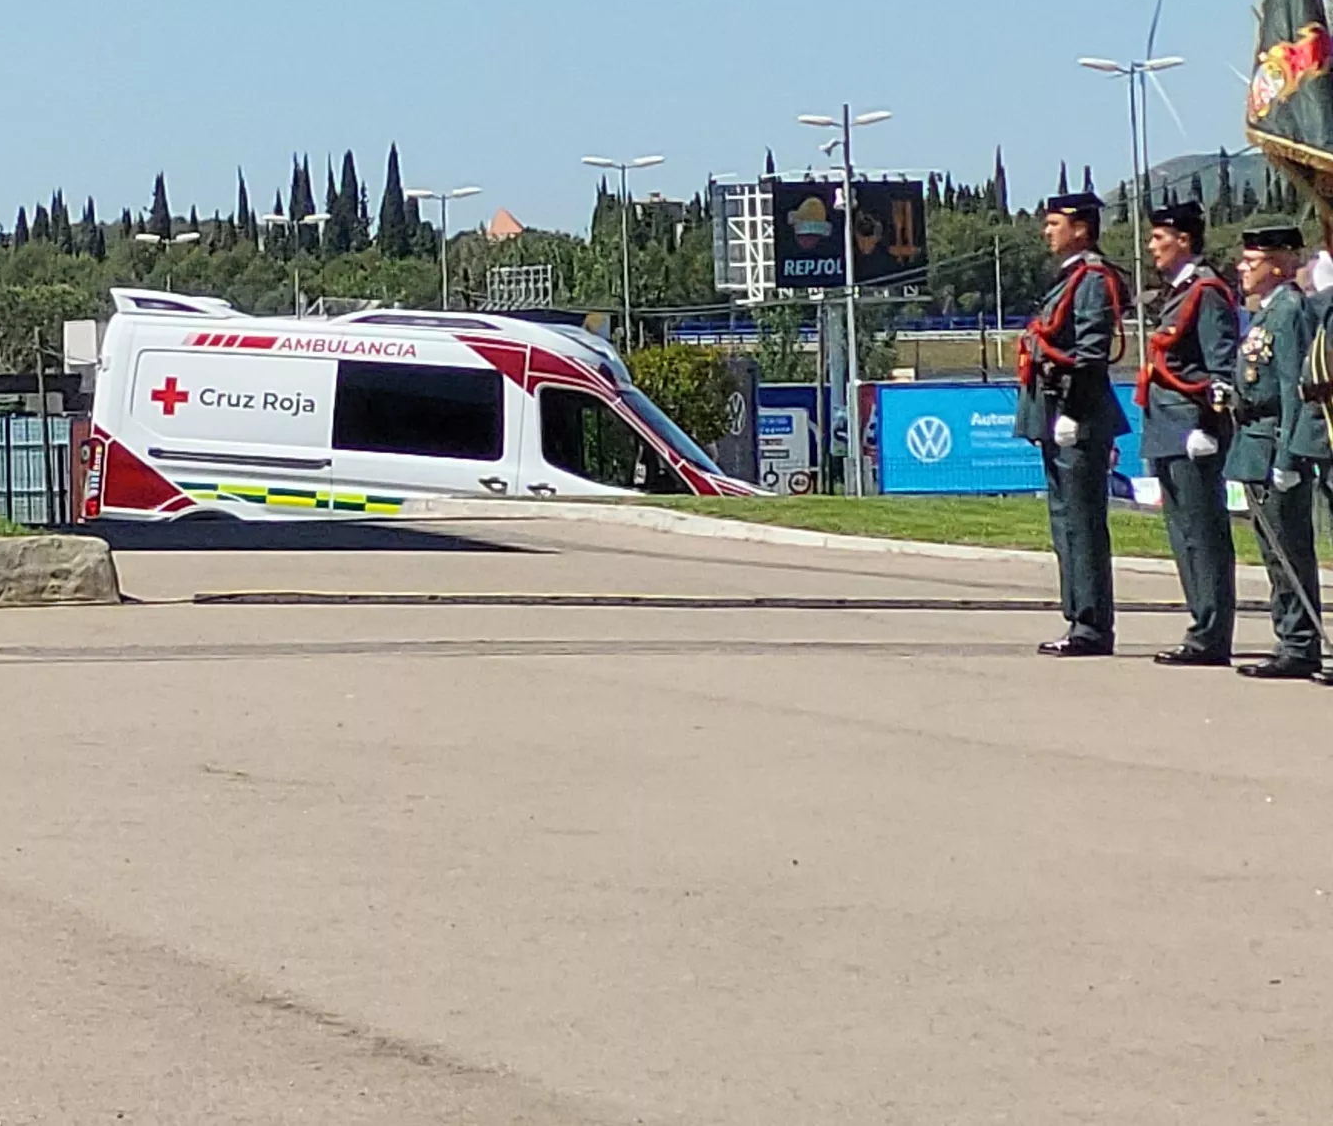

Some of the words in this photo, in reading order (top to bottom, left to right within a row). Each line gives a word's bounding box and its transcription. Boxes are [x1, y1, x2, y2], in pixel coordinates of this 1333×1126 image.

[783, 258, 844, 276] REPSOL
[277, 336, 418, 358] AMBULANCIA
[199, 387, 255, 410] Cruz
[262, 391, 316, 416] Roja
